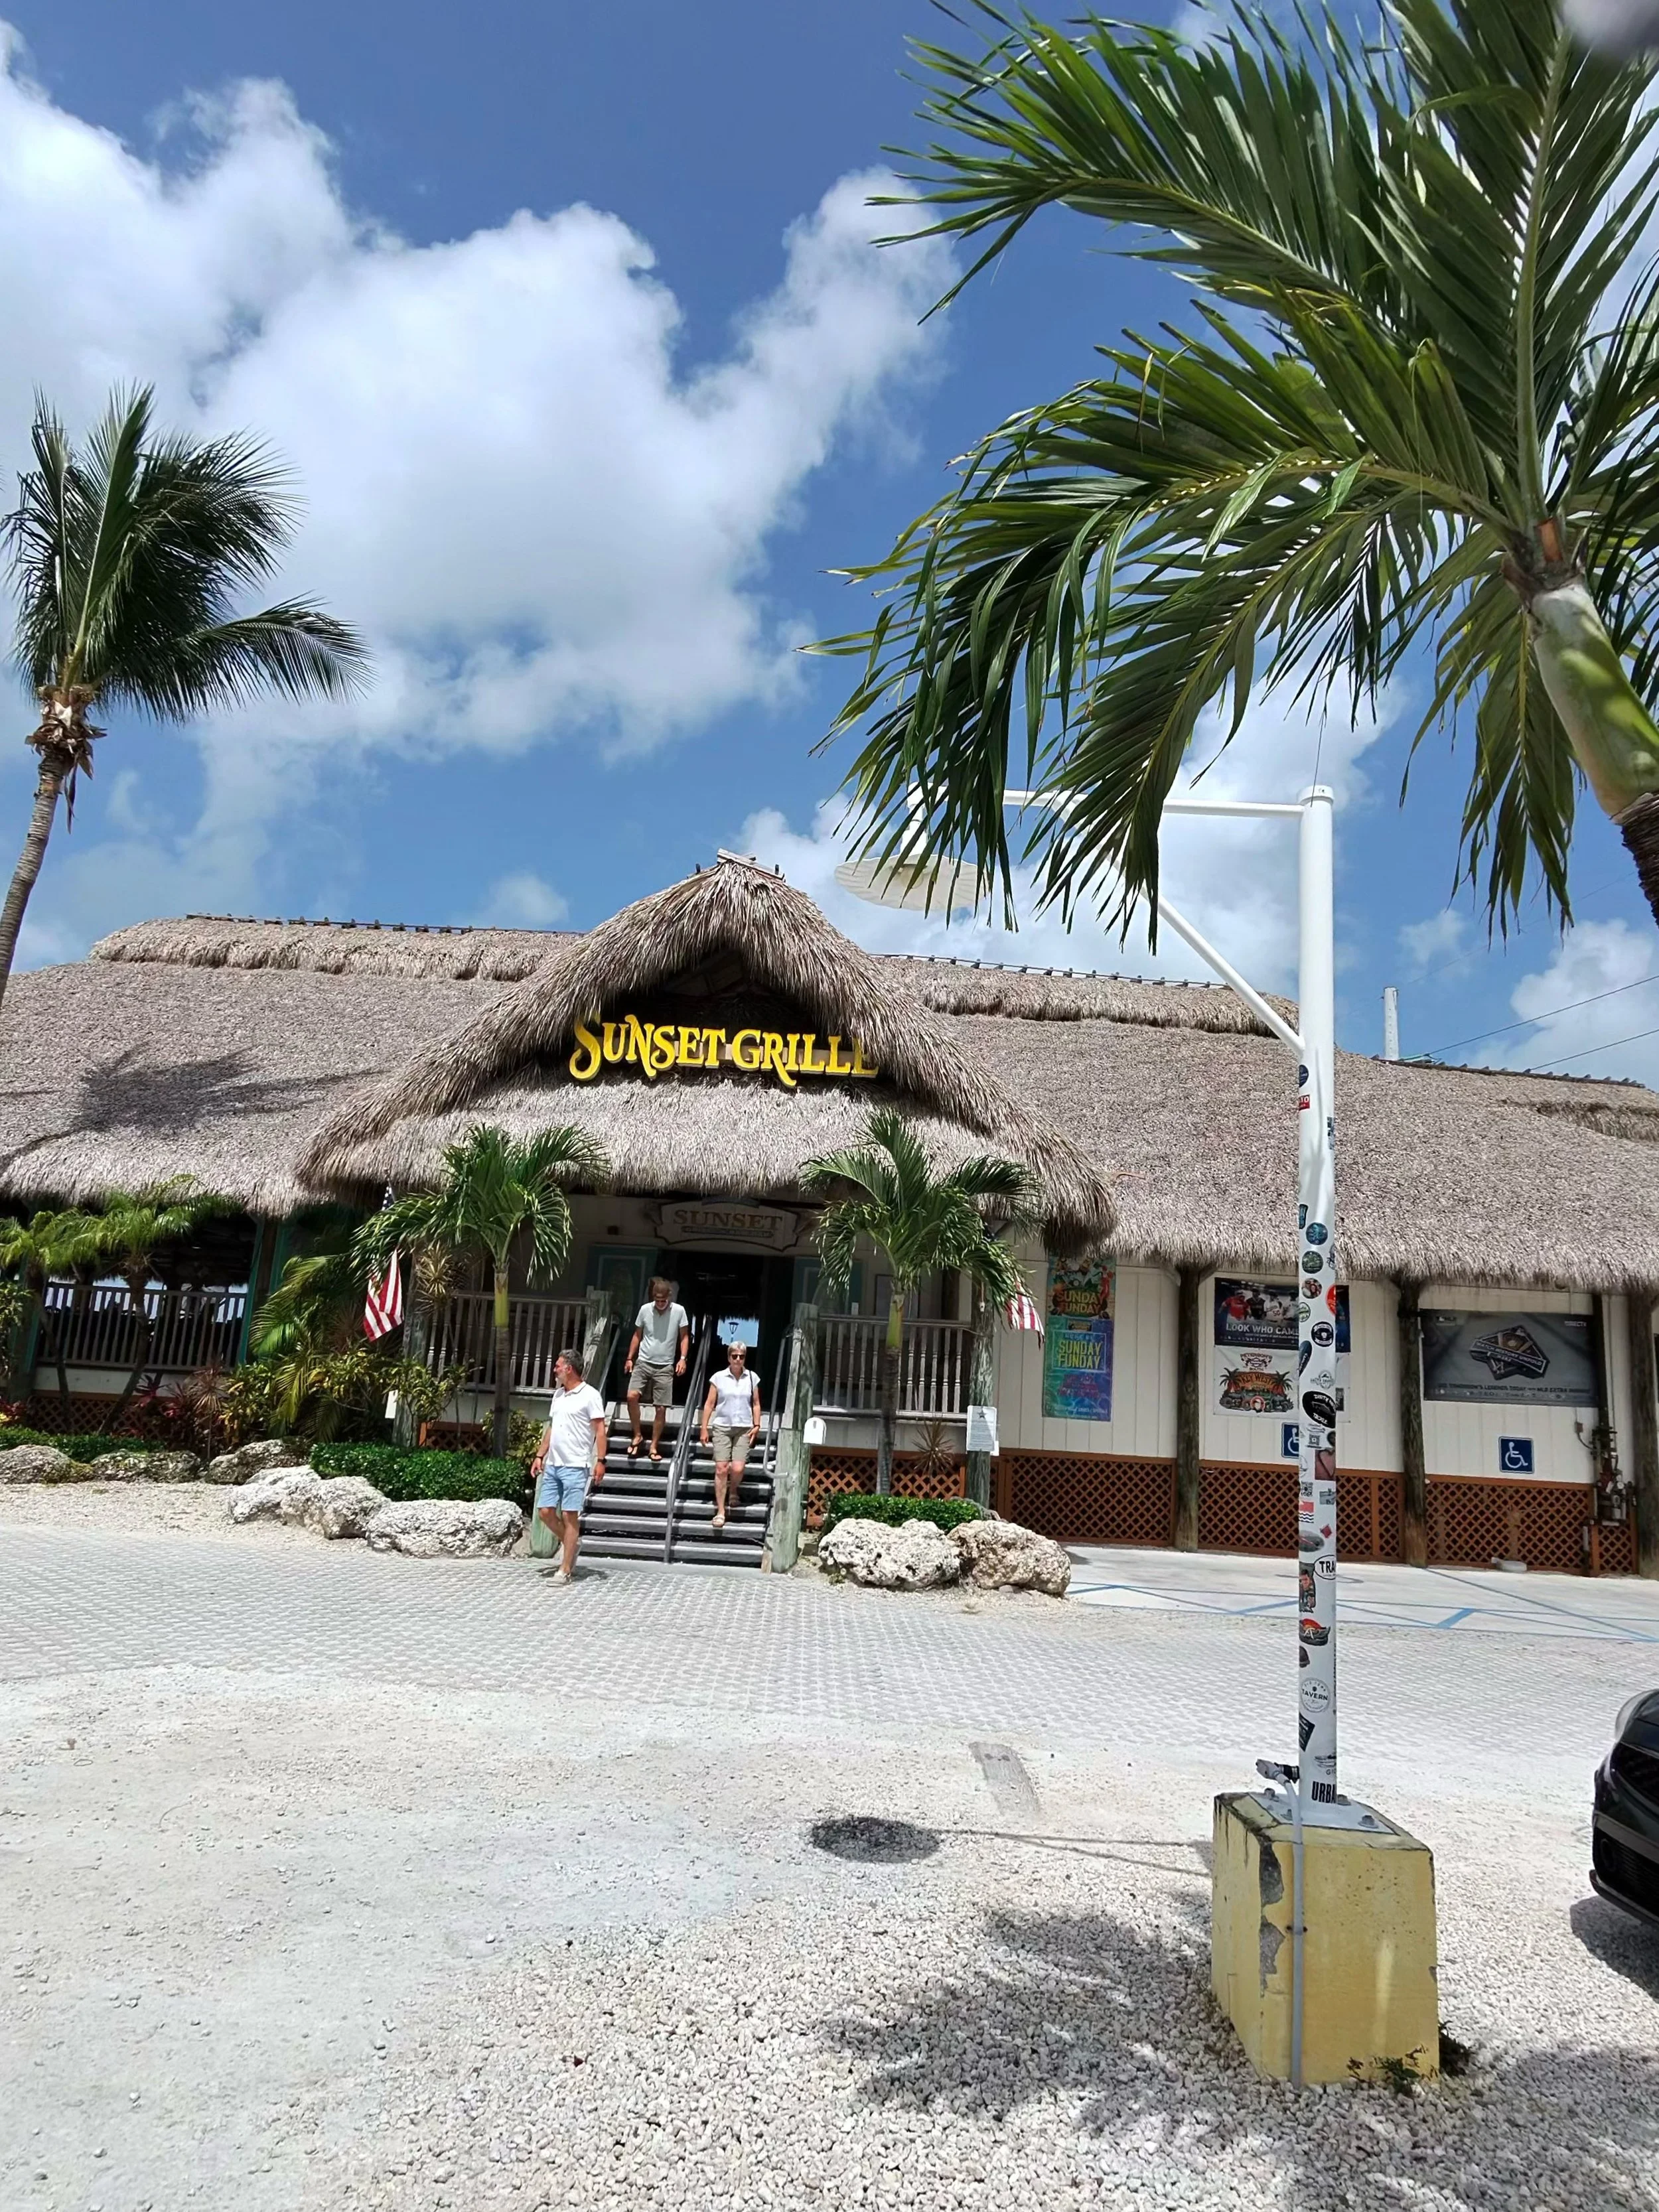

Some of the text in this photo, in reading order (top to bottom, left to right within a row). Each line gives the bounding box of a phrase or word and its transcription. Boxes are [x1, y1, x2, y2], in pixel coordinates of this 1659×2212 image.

[569, 1011, 726, 1081] SUNSET
[673, 1209, 783, 1231] SUNSET
[1055, 1290, 1105, 1305] SUNDAY
[1226, 1322, 1250, 1332] LOOK
[1252, 1325, 1273, 1334] WHO
[1058, 1340, 1103, 1355] SUNDAY
[1495, 1348, 1519, 1358] HISTORY
[1058, 1353, 1102, 1369] FUNDAY
[1302, 1688, 1329, 1700] TAVERN
